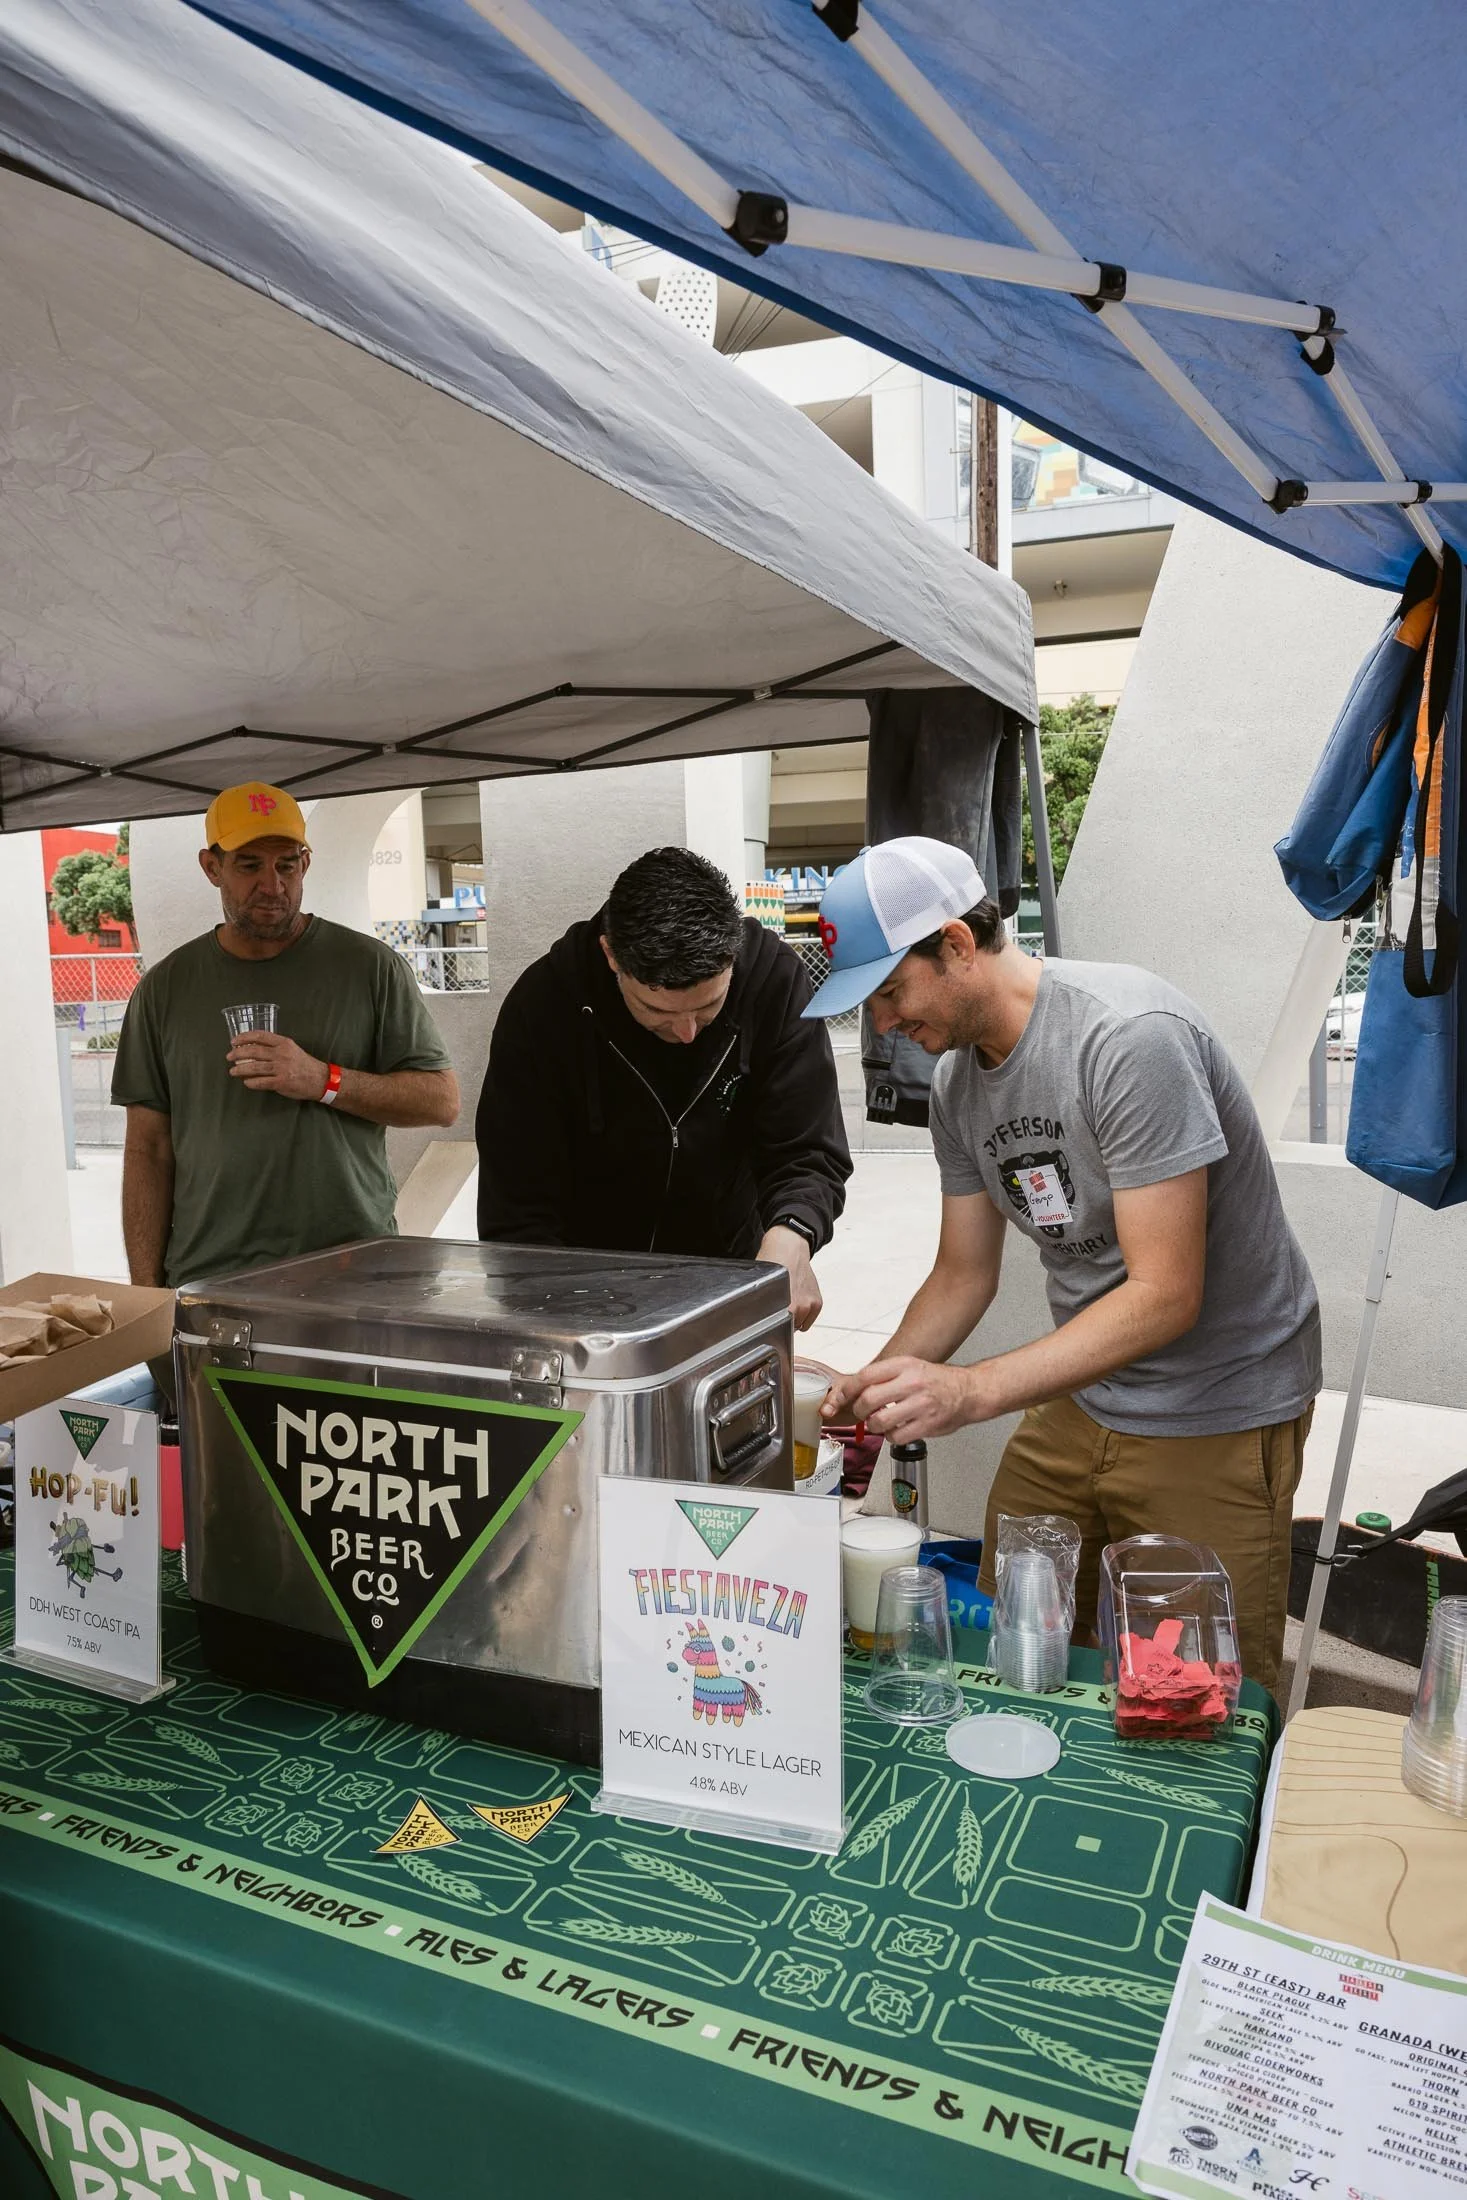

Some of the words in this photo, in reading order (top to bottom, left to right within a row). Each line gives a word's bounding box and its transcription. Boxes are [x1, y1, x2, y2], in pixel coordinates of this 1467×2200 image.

[1037, 1213, 1065, 1223] VOLUNTEER
[69, 1415, 99, 1432] NORTH
[73, 1425, 96, 1438] PARK
[277, 1403, 490, 1499] NORTH
[301, 1461, 462, 1540] PARK
[692, 1506, 741, 1524] NORTH
[699, 1518, 736, 1533] PARK
[331, 1527, 434, 1580] BEER
[352, 1569, 400, 1606] CO
[29, 1596, 51, 1615] DDH
[52, 1602, 81, 1623] WEST
[83, 1611, 122, 1634] COAST
[124, 1622, 141, 1640] IPA
[629, 1568, 809, 1639] FIESTAVEZA
[84, 1640, 102, 1654] ABV
[618, 1728, 698, 1758] MEXICAN
[701, 1741, 756, 1768] STYLE
[761, 1751, 822, 1778] LAGER
[719, 1780, 748, 1797] ABV
[491, 1803, 553, 1821] NORTH
[500, 1812, 546, 1827] PARK
[389, 1813, 429, 1849] NORTH
[404, 1821, 436, 1848] PARK
[509, 1821, 538, 1833] BEER
[51, 1814, 181, 1860] FRIENDS
[176, 1853, 203, 1875] &
[203, 1862, 384, 1930] NEIGHBORS
[404, 1927, 499, 1966] ALES
[502, 1956, 528, 1981] &
[537, 1968, 695, 2029] LAGERS
[727, 2027, 921, 2103] FRIENDS
[933, 2089, 965, 2120] &
[1311, 1945, 1360, 1968] DRINK
[1362, 1960, 1407, 1979] MENU
[1201, 1953, 1240, 1972] 29TH
[1243, 1966, 1262, 1978] ST
[1264, 1973, 1311, 1996] (EAST)
[1316, 1991, 1347, 2008] BAR
[1201, 1978, 1220, 1989] OLDE
[1244, 1993, 1282, 2009] AMERICAN
[1285, 2005, 1308, 2017] LAGER
[1332, 2022, 1349, 2031] ABV
[1237, 1981, 1270, 1997] BLACK
[1272, 1992, 1311, 2010] PLAGUE
[1235, 2010, 1250, 2018] ARE
[1252, 2015, 1265, 2023] OFF
[1267, 2020, 1286, 2030] PALE
[1288, 2027, 1302, 2035] ALE
[1326, 2039, 1343, 2047] ABV
[1259, 2007, 1285, 2021] SEEK
[1218, 2024, 1256, 2041] JAPANESE
[1258, 2038, 1282, 2050] LAGER
[1299, 2053, 1316, 2061] ABV
[1244, 2022, 1294, 2044] HARLAND
[1358, 2021, 1434, 2050] GRANADA
[1203, 2039, 1252, 2061] BIVOUAC
[1254, 2055, 1325, 2087] CIDERWORKS
[1228, 2036, 1248, 2046] HAZY
[1250, 2043, 1263, 2051] IPA
[1288, 2057, 1305, 2065] ABV
[1354, 2047, 1366, 2055] GO
[1389, 2058, 1410, 2069] TURN
[1431, 2071, 1457, 2083] HOPPY
[1409, 2052, 1460, 2075] ORIGINAL
[1237, 2061, 1260, 2073] SALSA
[1262, 2070, 1287, 2082] CIDER
[1199, 2069, 1237, 2087] NORTH
[1239, 2081, 1269, 2100] PARK
[1271, 2094, 1300, 2110] BEER
[1302, 2104, 1318, 2117] CO
[1257, 2076, 1301, 2096] PINEAPPLE
[1310, 2096, 1335, 2109] CIDER
[1391, 2081, 1422, 2096] BARRIO
[1424, 2091, 1451, 2105] LAGER
[1421, 2078, 1460, 2097] THORN
[1171, 2071, 1218, 2091] FIESTAVEZA
[1236, 2094, 1254, 2104] ABV
[1325, 2127, 1344, 2137] ABV
[1226, 2101, 1250, 2117] UNA
[1253, 2111, 1279, 2128] MAS
[1393, 2105, 1422, 2120] MELON
[1423, 2115, 1448, 2128] DROP
[1408, 2097, 1429, 2111] 619
[1169, 2095, 1219, 2116] STRUMMERS
[1221, 2112, 1236, 2122] ALE
[1239, 2118, 1270, 2135] VIENNA
[1273, 2132, 1299, 2146] LAGER
[1318, 2149, 1336, 2159] ABV
[1188, 2110, 1215, 2123] PUNTA
[1217, 2120, 1239, 2132] BAJA
[1241, 2129, 1269, 2143] LAGER
[1295, 2149, 1313, 2160] ABV
[1376, 2124, 1406, 2139] ACTIVE
[1408, 2134, 1423, 2144] IPA
[1425, 2140, 1462, 2156] SESSION
[1424, 2127, 1459, 2144] HELIX
[1367, 2146, 1402, 2163] VARIETY
[1404, 2159, 1416, 2168] OF
[1383, 2138, 1437, 2162] ATHLETIC
[1197, 2157, 1238, 2179] THORN
